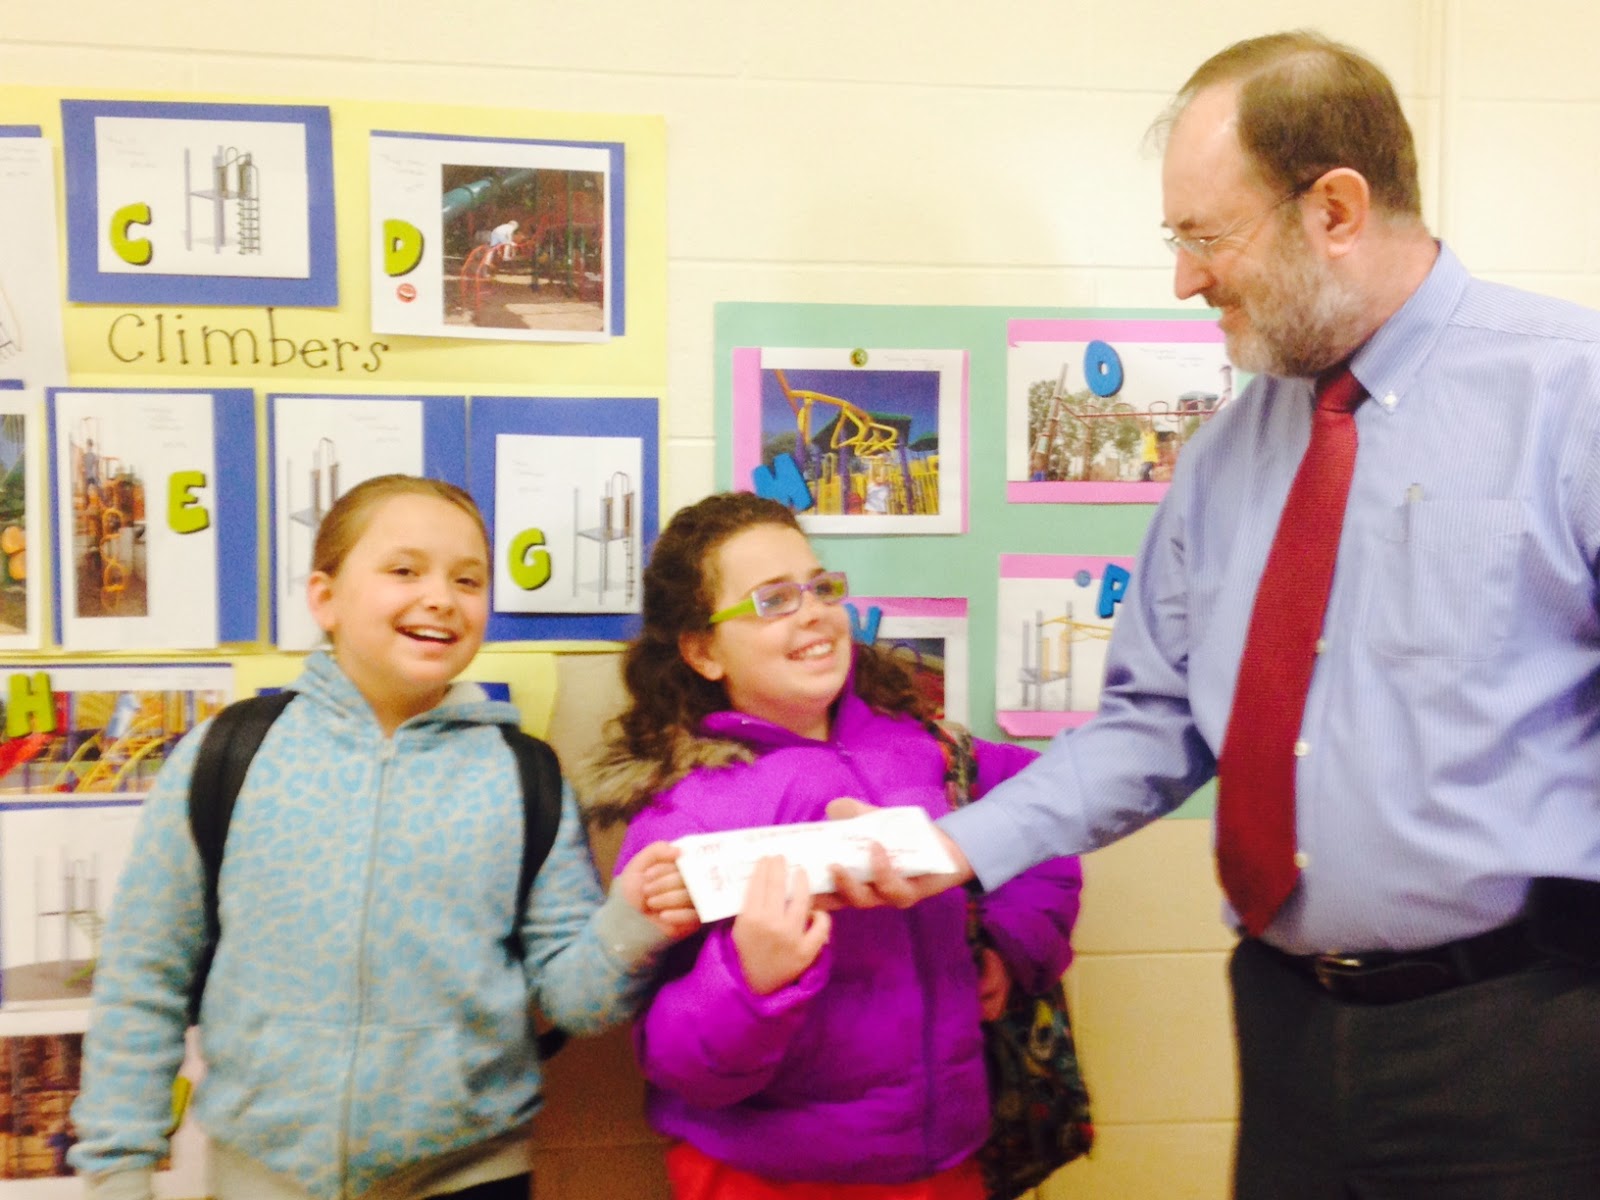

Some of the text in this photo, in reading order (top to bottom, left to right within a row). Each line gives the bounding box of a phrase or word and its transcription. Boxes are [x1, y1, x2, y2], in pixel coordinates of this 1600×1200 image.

[109, 201, 153, 266] C
[383, 218, 424, 277] D
[108, 307, 389, 372] Climbers
[167, 470, 210, 535] E
[508, 527, 552, 591] G
[1096, 563, 1131, 619] P
[7, 671, 55, 738] H
